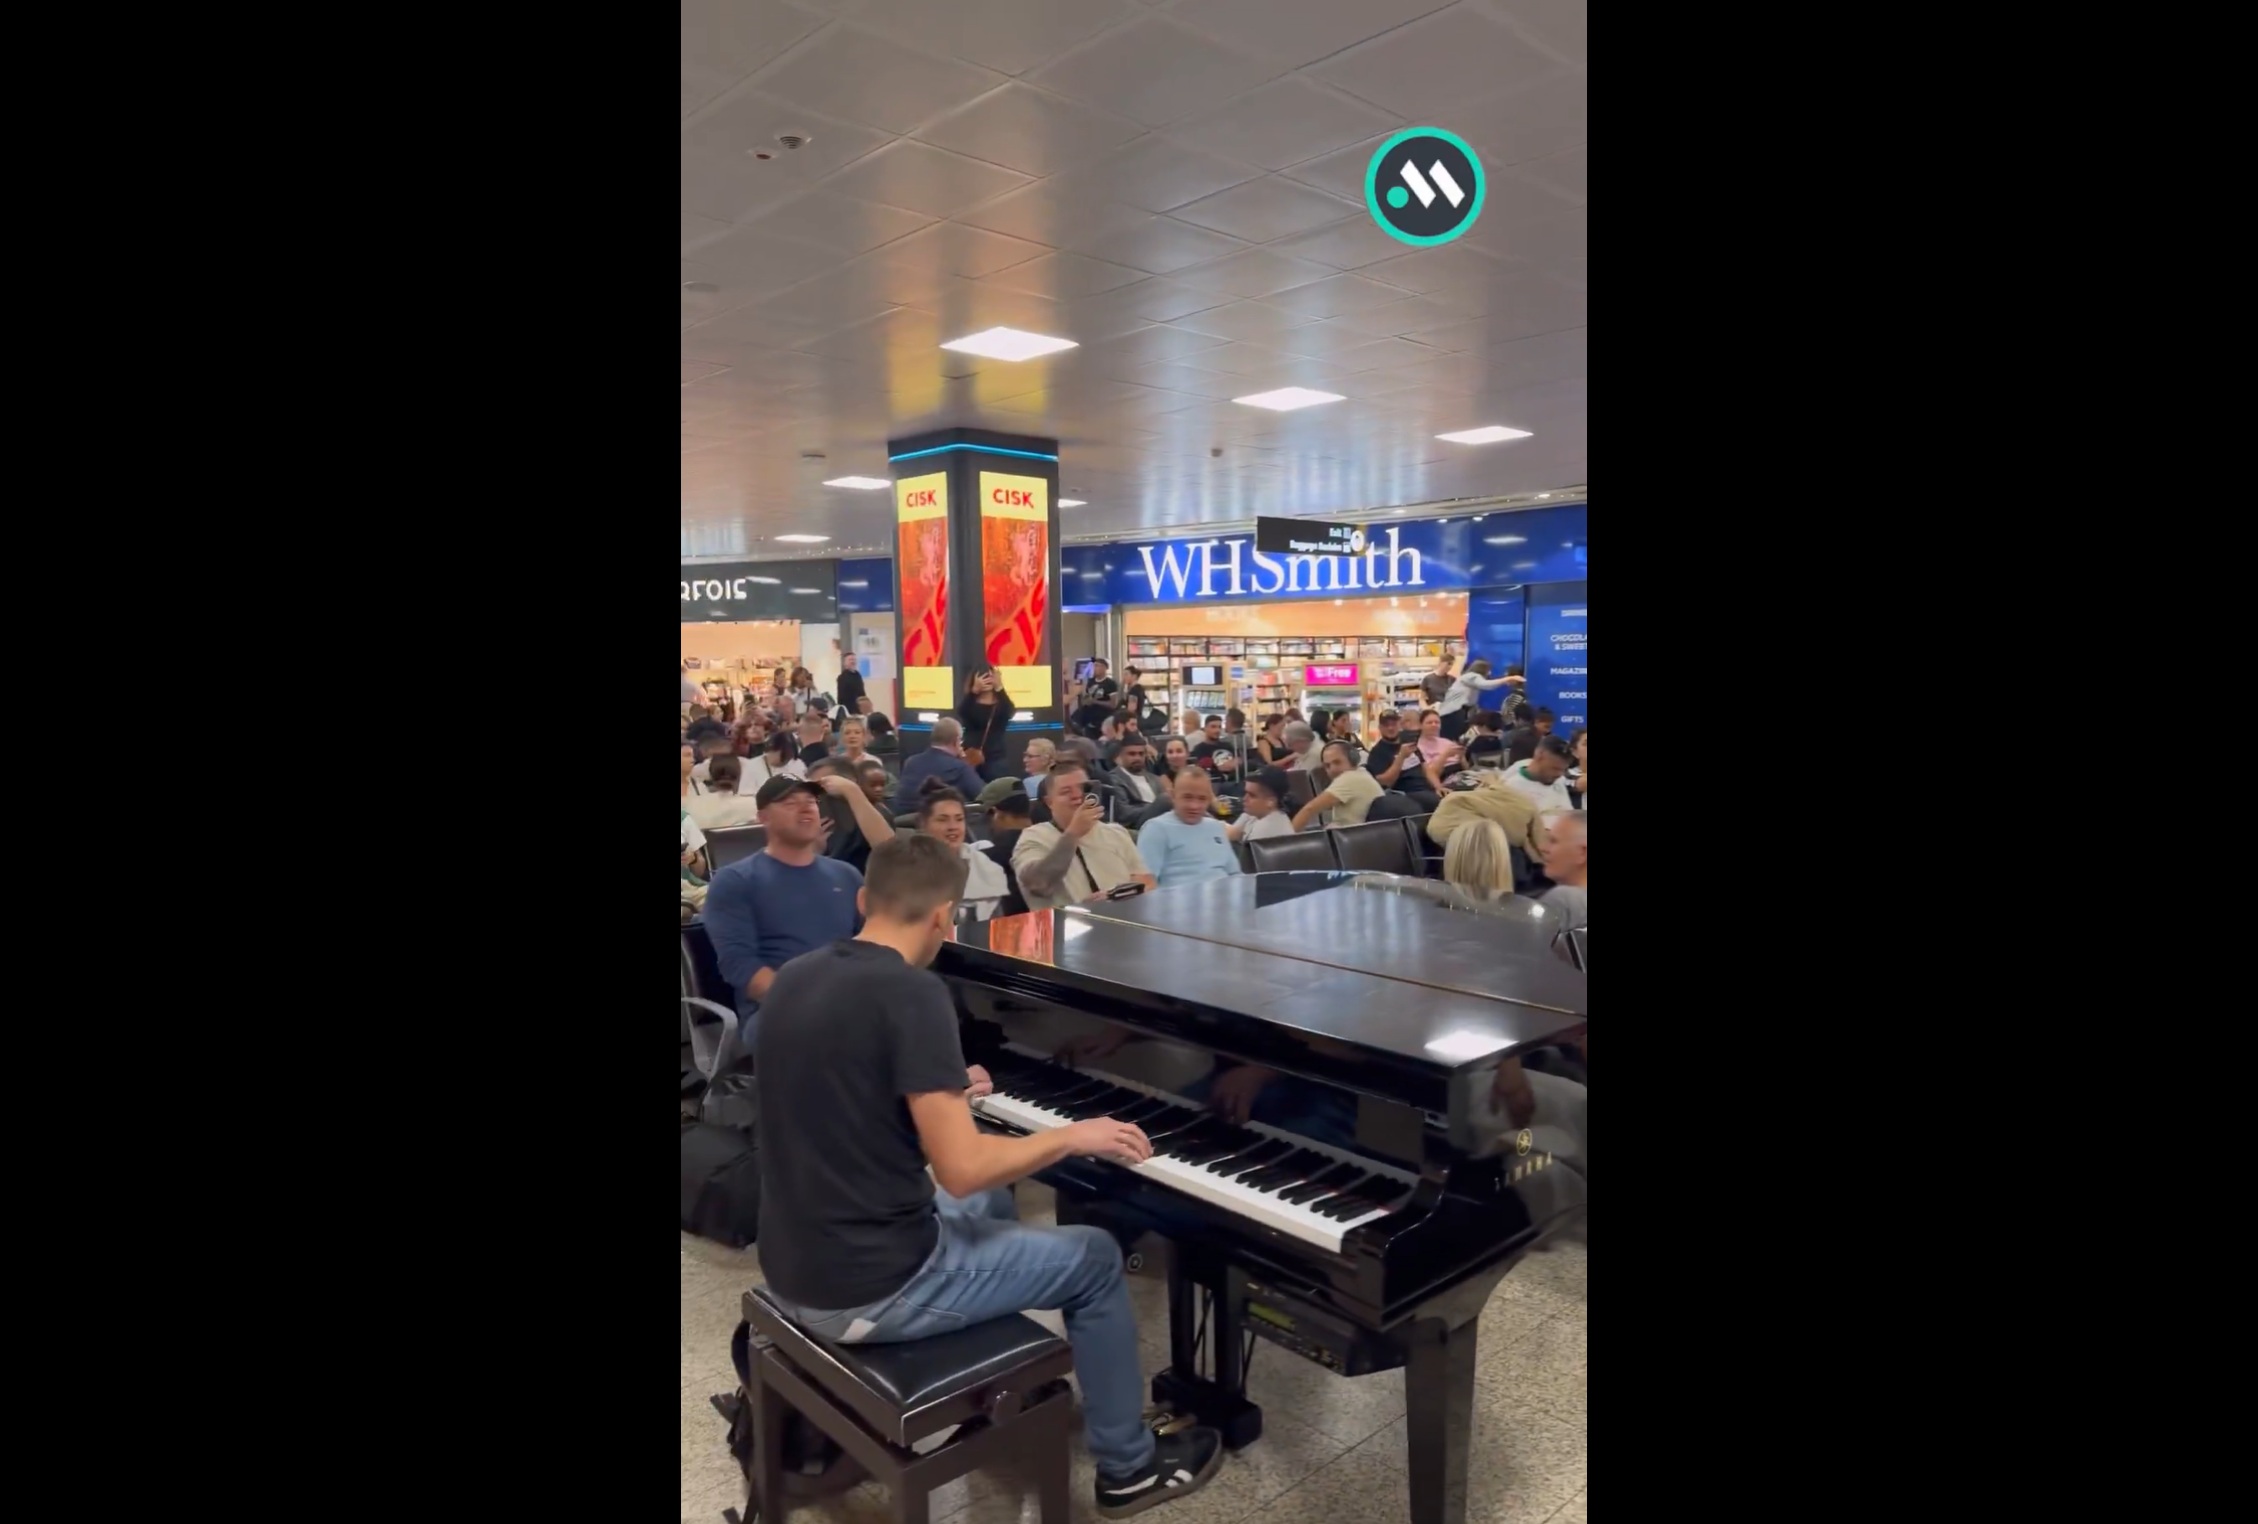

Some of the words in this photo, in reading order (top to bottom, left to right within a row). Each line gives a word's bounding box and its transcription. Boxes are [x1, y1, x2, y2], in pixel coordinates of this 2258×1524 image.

[905, 489, 938, 508] CISK
[992, 488, 1035, 509] CISK
[1137, 527, 1425, 599] WHSmith
